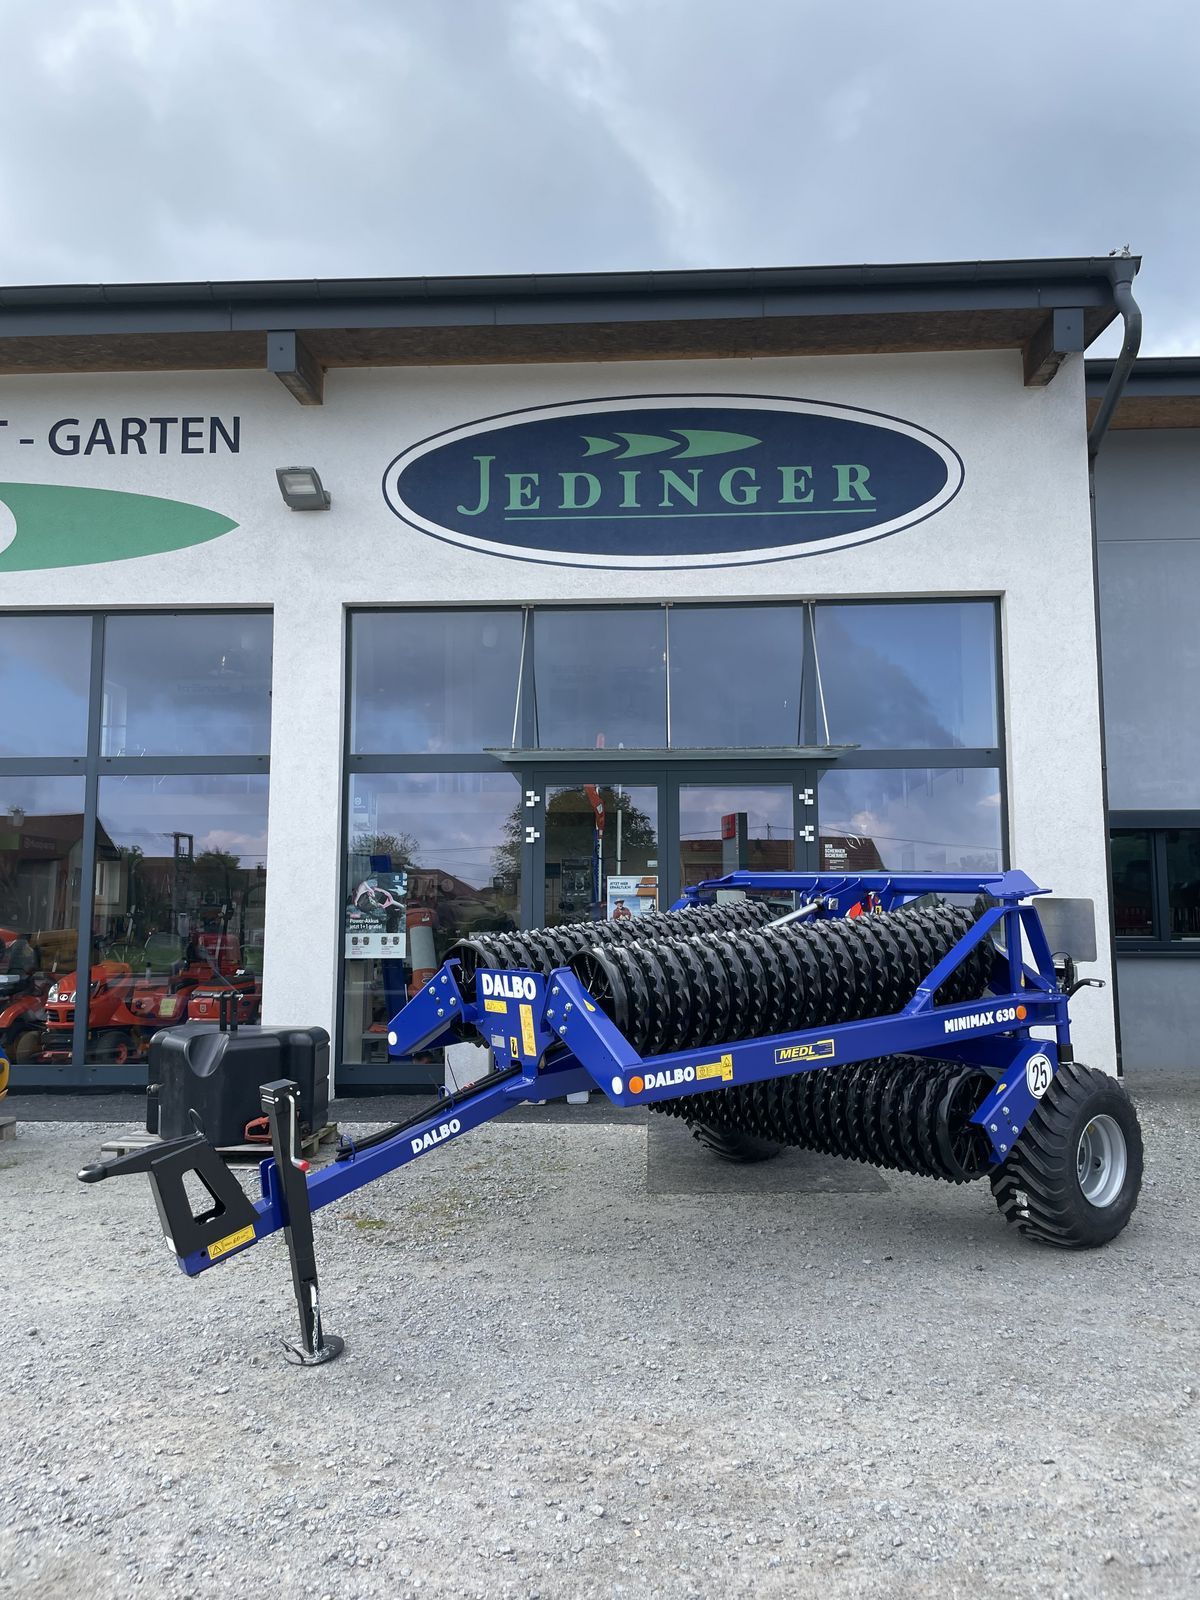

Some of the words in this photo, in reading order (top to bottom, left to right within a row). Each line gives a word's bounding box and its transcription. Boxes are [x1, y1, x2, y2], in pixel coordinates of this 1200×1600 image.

[48, 416, 240, 456] GARTEN
[456, 455, 877, 516] JEDINGER
[481, 973, 537, 1001] DALBO
[944, 1011, 994, 1034] MINIMAX
[996, 1007, 1016, 1022] 630
[780, 1045, 816, 1060] MEDL
[644, 1066, 695, 1090] DALBO
[1032, 1061, 1048, 1091] 25
[410, 1118, 461, 1154] DALBO
